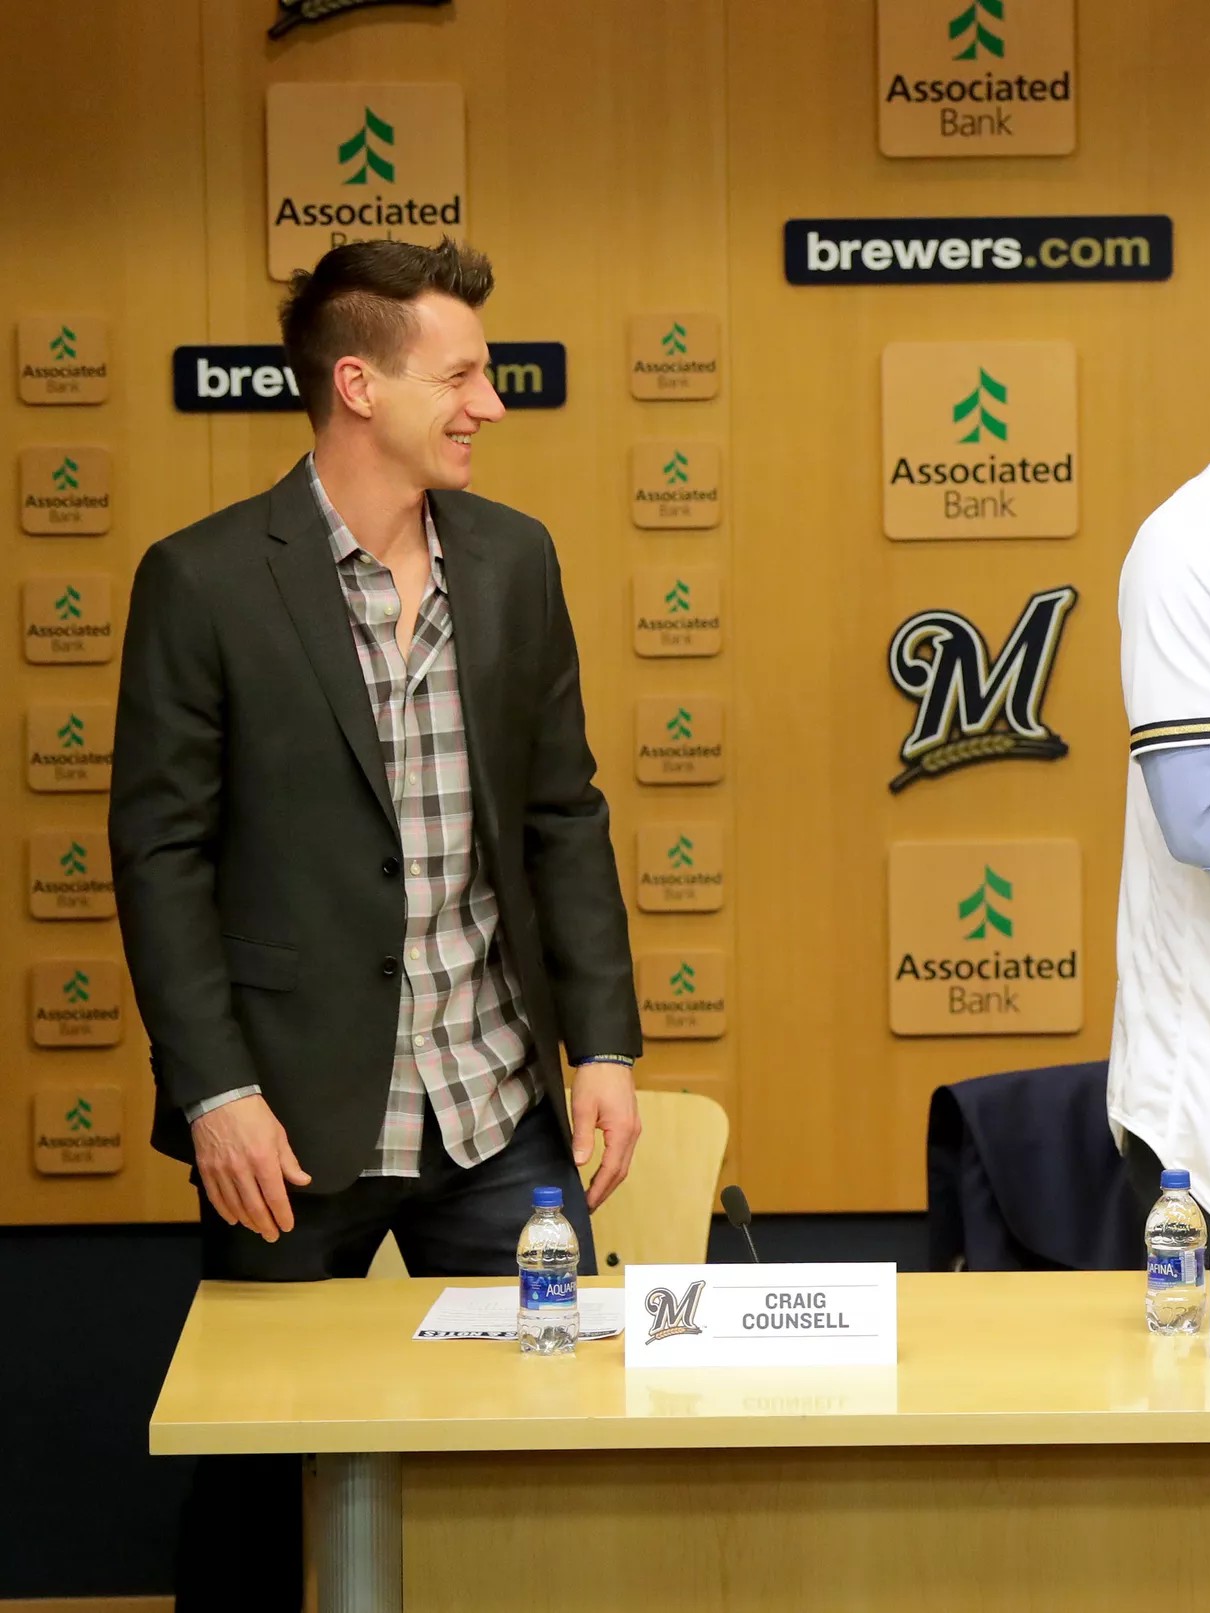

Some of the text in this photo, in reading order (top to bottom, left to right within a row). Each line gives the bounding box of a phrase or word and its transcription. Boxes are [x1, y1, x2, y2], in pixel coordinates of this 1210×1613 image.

[886, 71, 1070, 102] Associated
[940, 107, 1013, 137] Bank
[275, 196, 461, 226] Associated
[807, 231, 1150, 271] brewers.com
[22, 362, 106, 378] Associated
[633, 359, 716, 373] Associated
[890, 454, 1072, 485] Associated
[25, 493, 109, 508] Associated
[635, 487, 718, 502] Associated
[943, 488, 1018, 519] Bank
[27, 622, 111, 638] Associated
[637, 616, 720, 630] Associated
[888, 584, 1080, 764] M
[639, 744, 722, 758] Associated
[641, 871, 723, 887] Associated
[896, 950, 1077, 981] Associated
[643, 998, 725, 1013] Associated
[948, 984, 1021, 1015] Bank
[37, 1005, 120, 1021] Associated
[39, 1133, 121, 1149] Associated
[765, 1292, 827, 1310] CRAIG
[742, 1312, 850, 1330] COUNSELL
